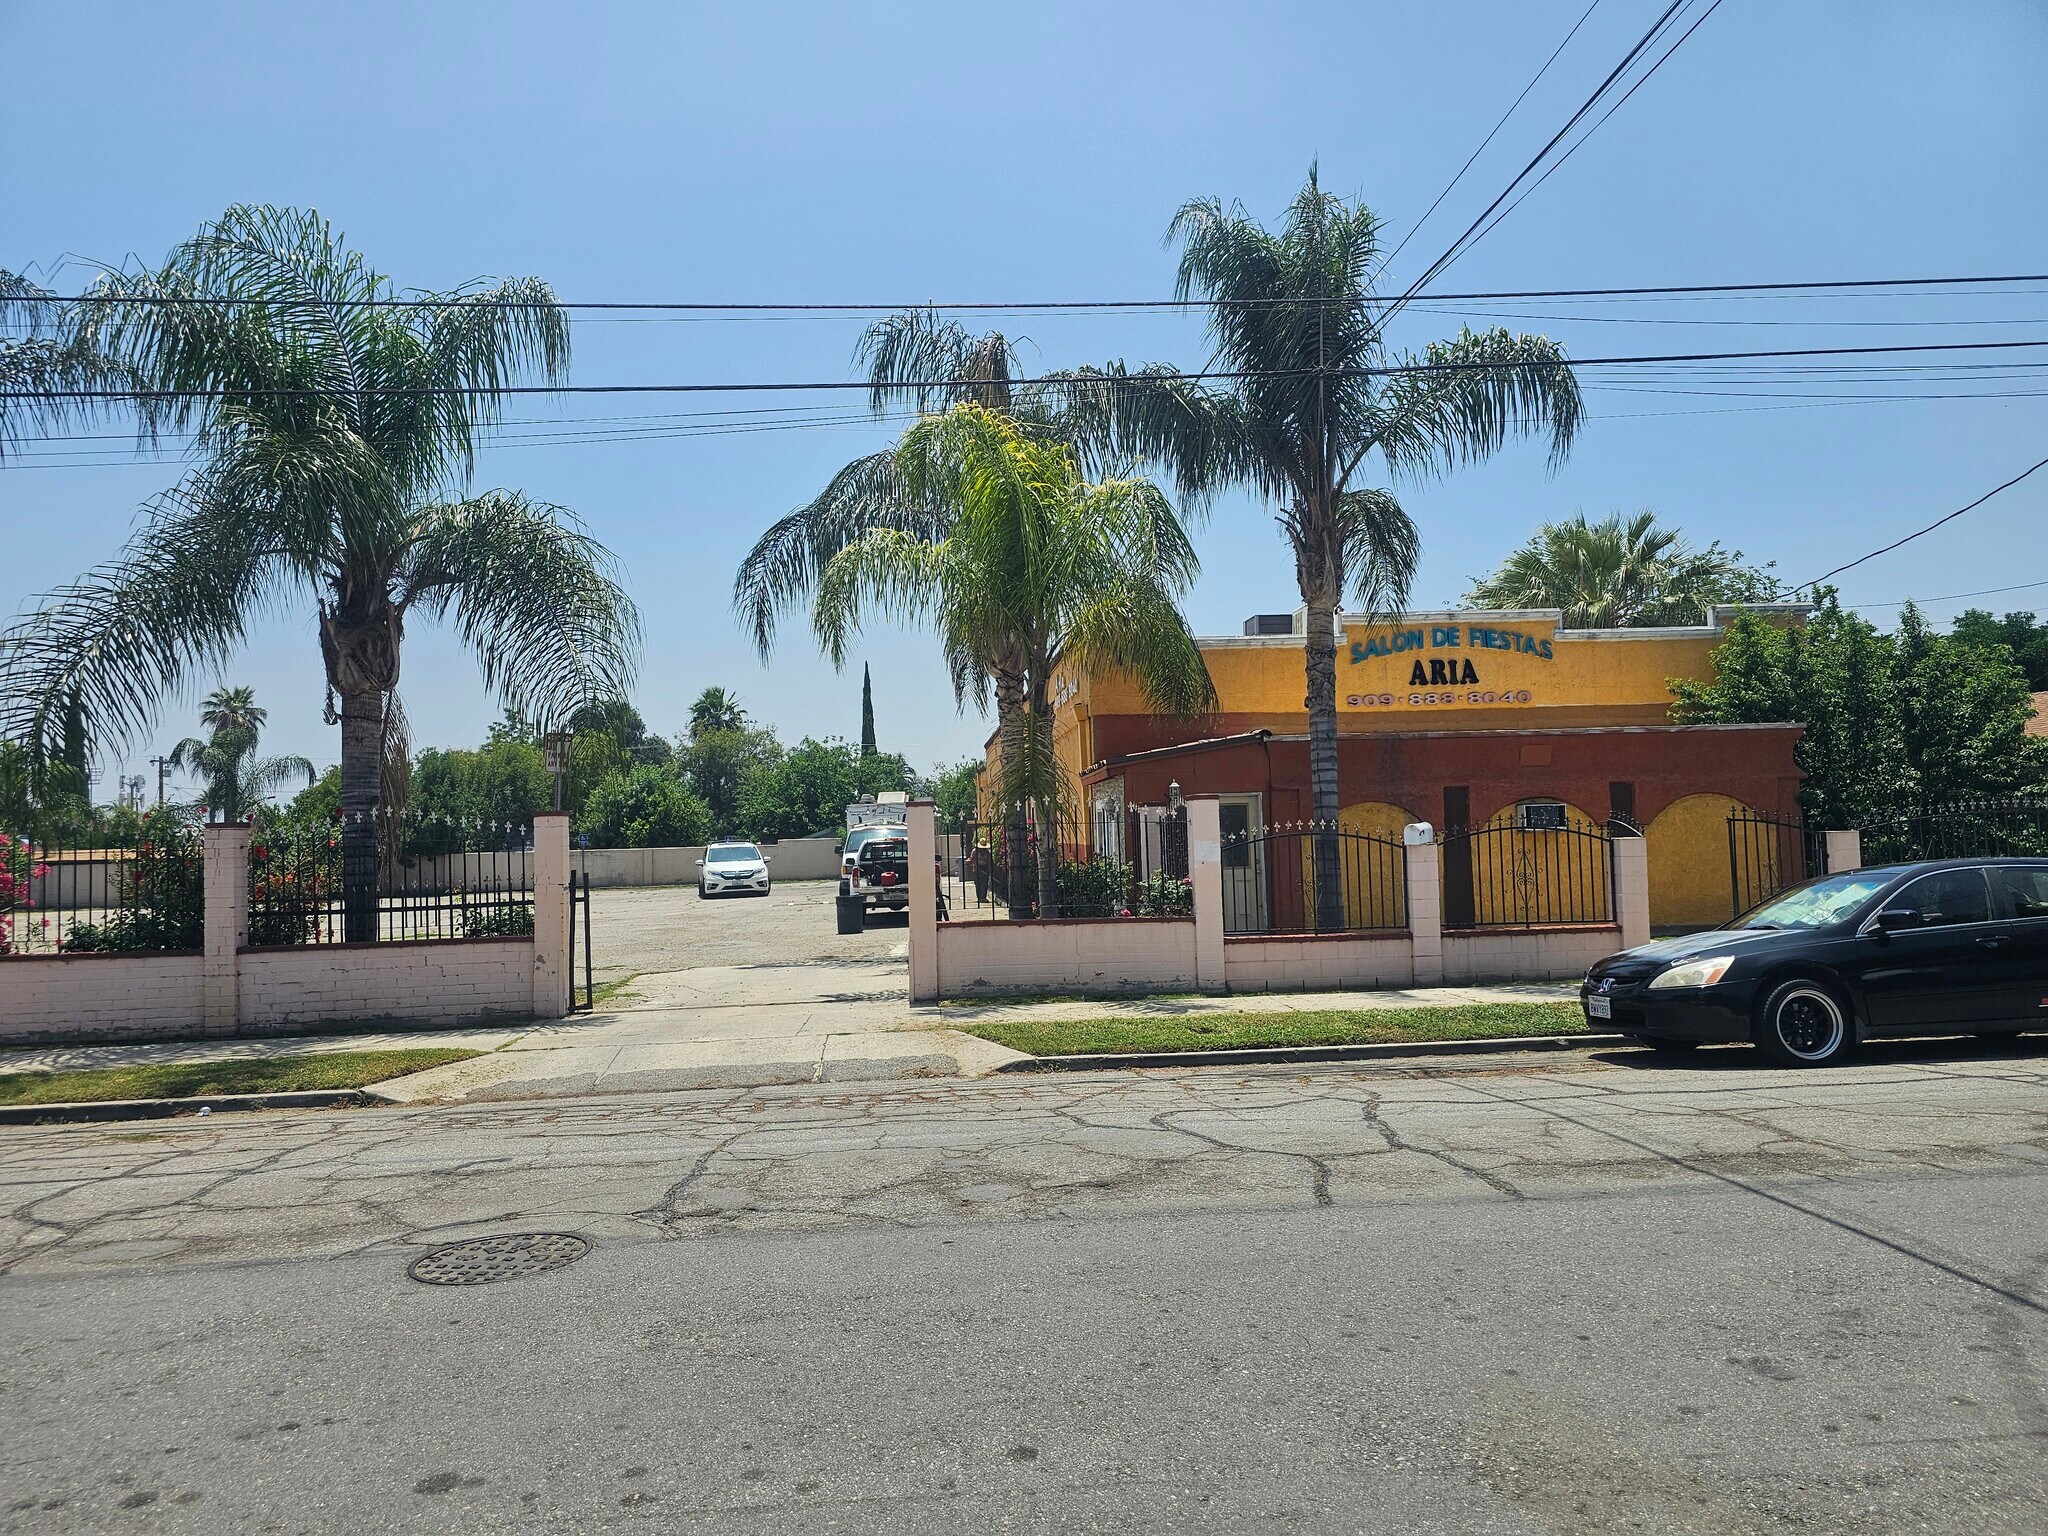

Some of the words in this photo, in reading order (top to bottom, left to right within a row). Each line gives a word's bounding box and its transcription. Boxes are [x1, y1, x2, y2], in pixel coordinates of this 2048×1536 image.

[1351, 630, 1424, 665] SALON
[1432, 627, 1460, 648] DE
[1469, 628, 1553, 660] FIESTAS
[1409, 659, 1480, 686] ARIA
